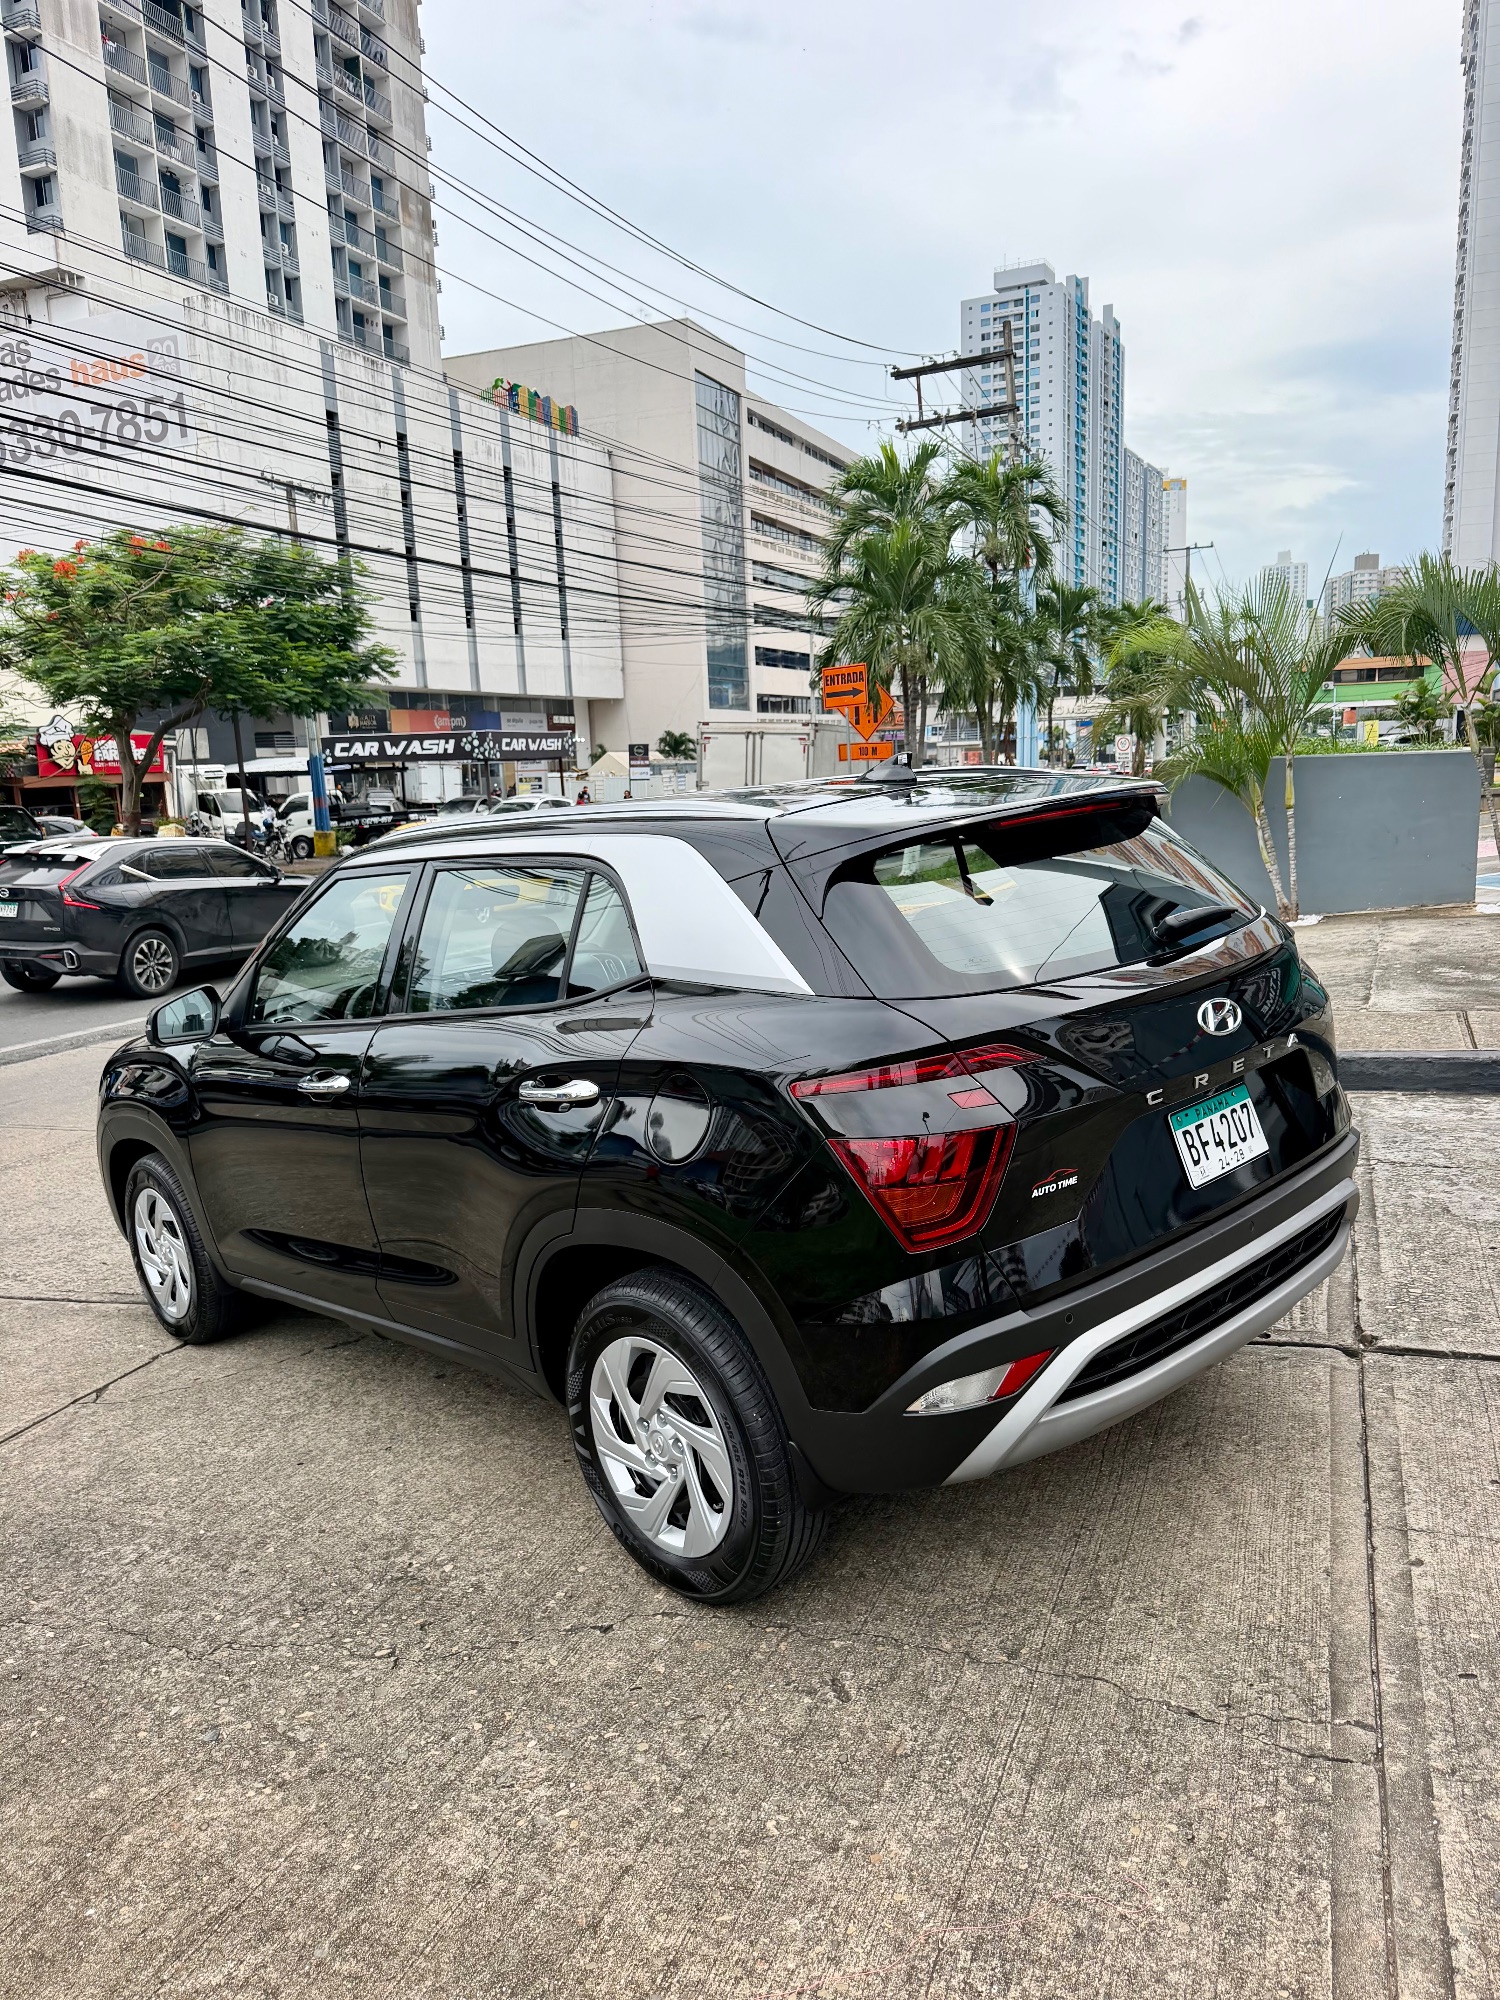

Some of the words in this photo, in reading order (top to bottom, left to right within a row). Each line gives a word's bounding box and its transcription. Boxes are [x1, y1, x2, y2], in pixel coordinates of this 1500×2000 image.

[151, 338, 176, 366] 20
[70, 352, 147, 388] haus
[824, 671, 865, 687] ENTRADA
[333, 741, 380, 758] CAR
[383, 739, 456, 757] WASH
[501, 738, 527, 751] CAR
[527, 738, 562, 751] WASH
[871, 746, 878, 756] M
[1146, 1033, 1299, 1105] CRETA
[1194, 1096, 1231, 1119] PANAMA
[1181, 1102, 1255, 1167] BF4207
[1031, 1183, 1057, 1198] AUTO
[1057, 1175, 1078, 1190] TIME
[718, 1411, 742, 1464] 205/65
[737, 1467, 747, 1496] R16
[739, 1498, 748, 1529] 95H
